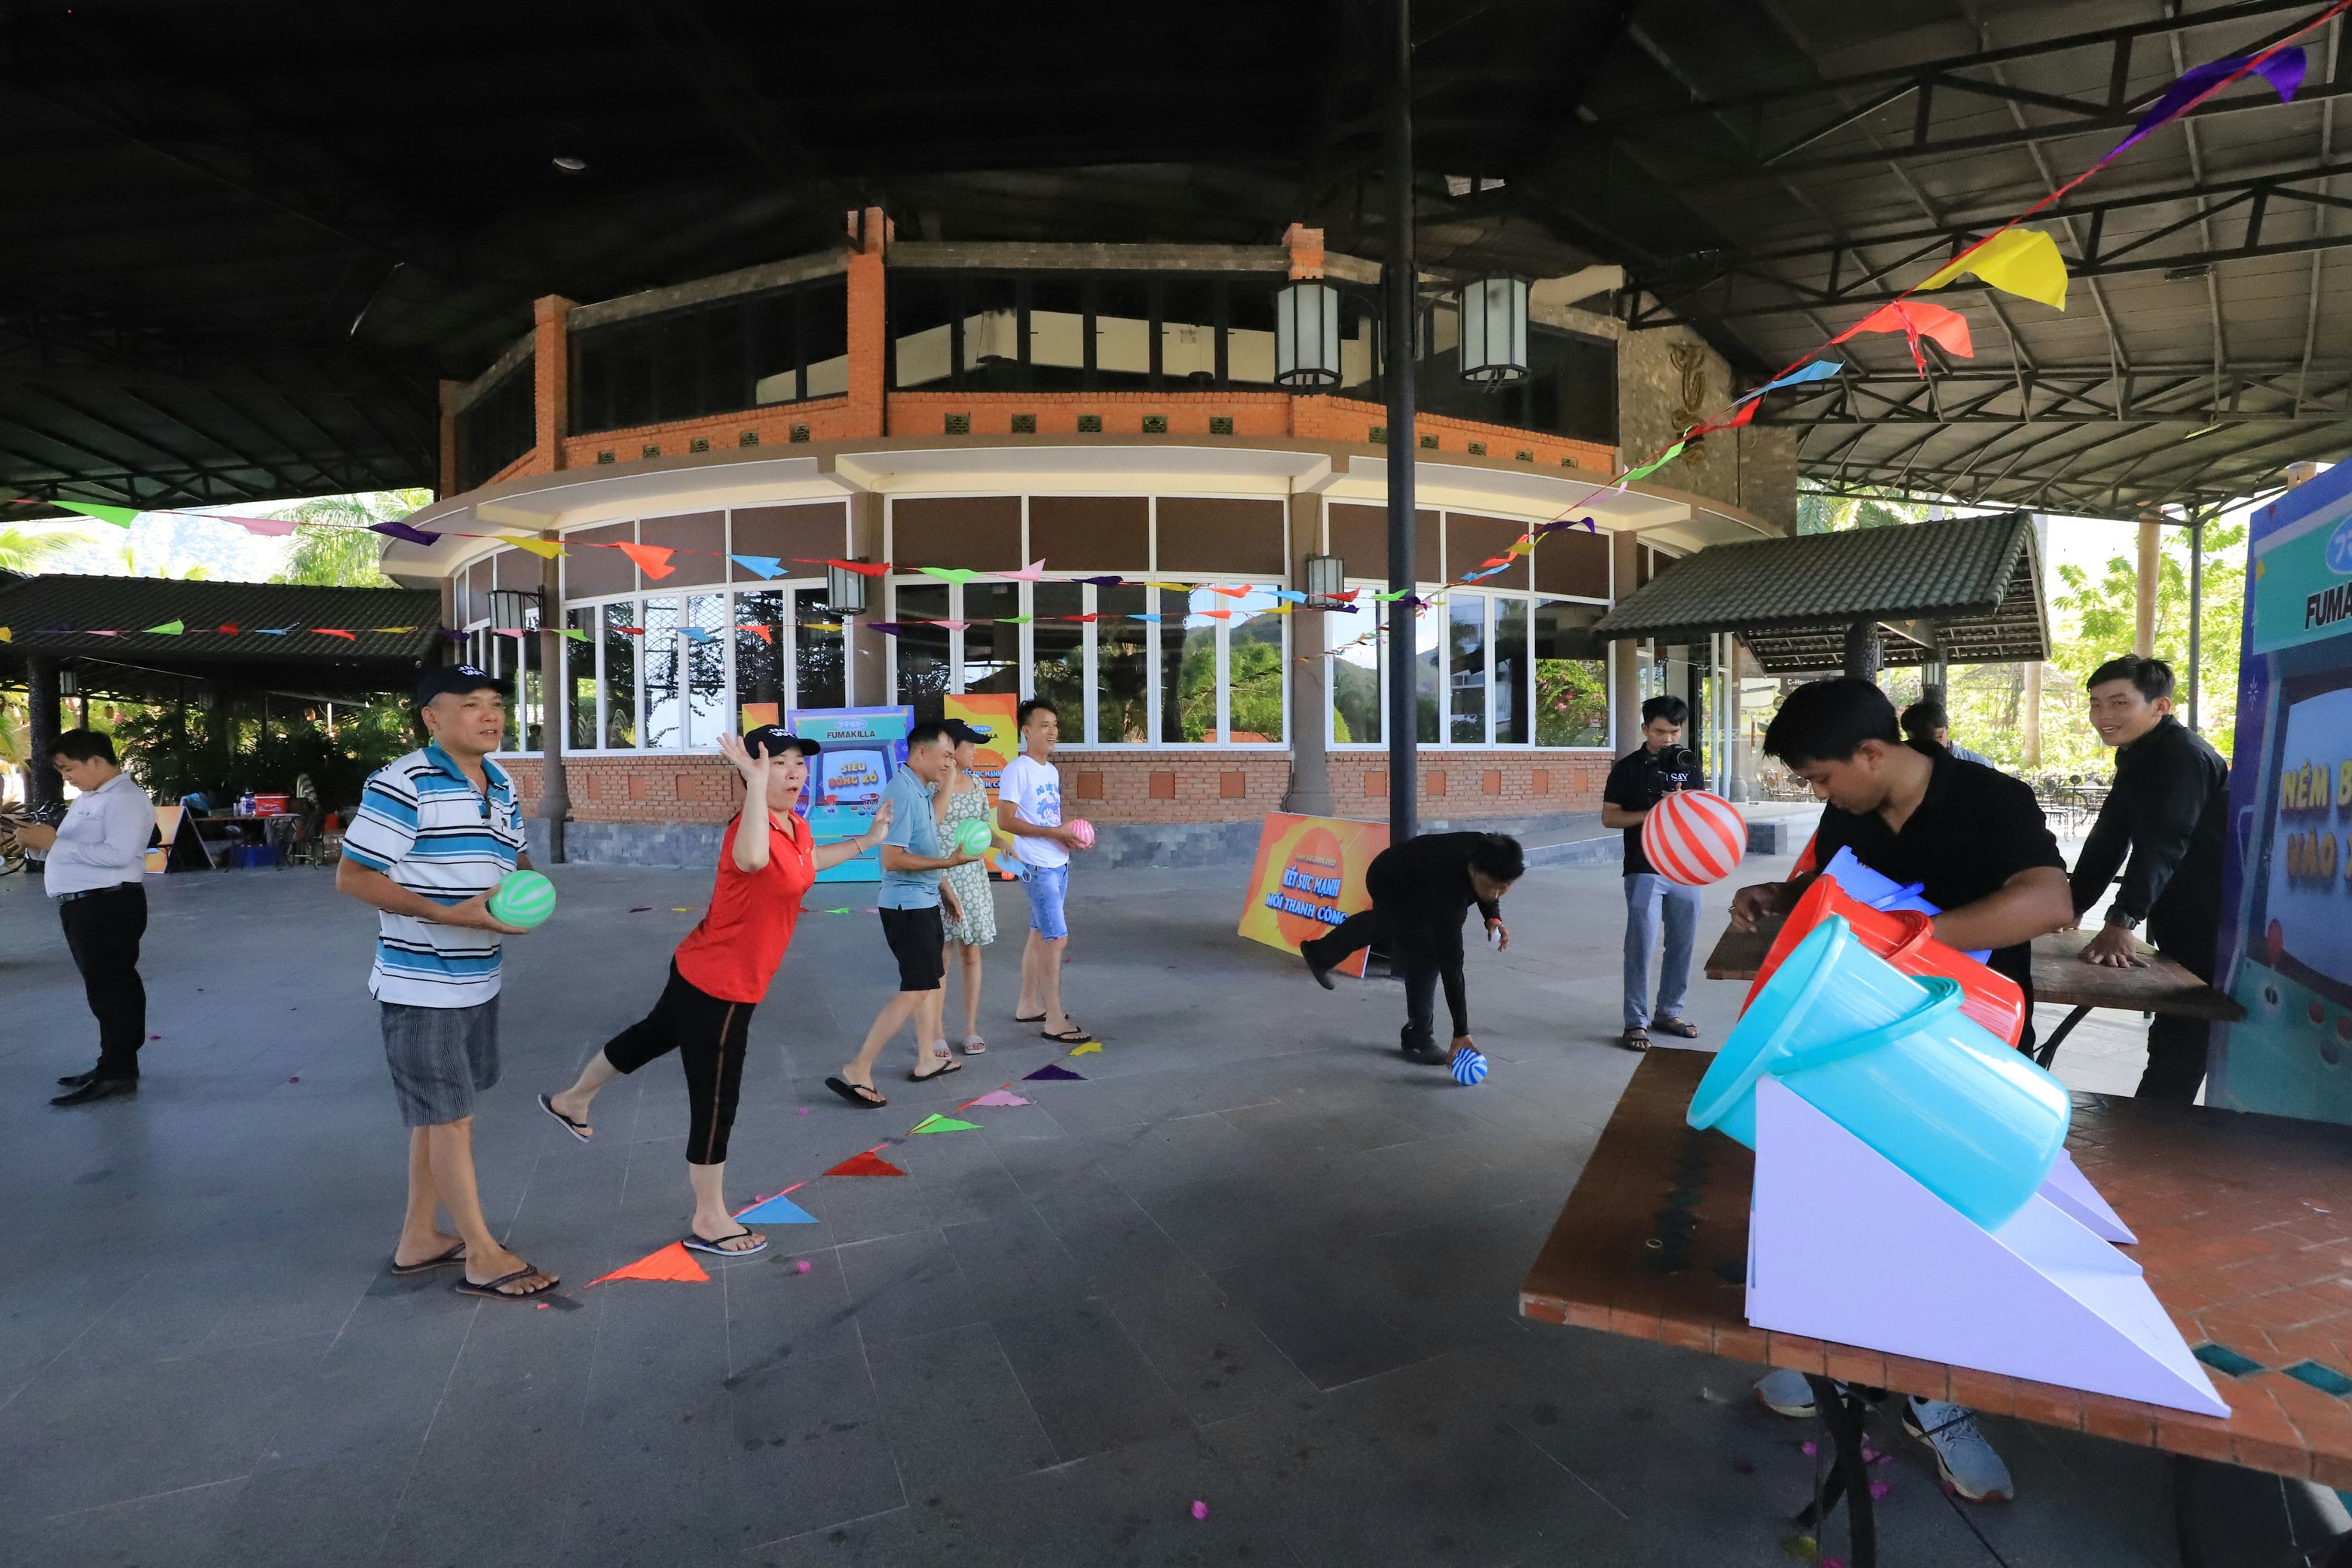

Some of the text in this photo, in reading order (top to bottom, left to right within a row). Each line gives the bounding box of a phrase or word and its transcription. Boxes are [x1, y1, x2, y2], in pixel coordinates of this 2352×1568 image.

[826, 730, 875, 739] FUMAKILLA
[2281, 759, 2329, 811] NÉM
[1282, 865, 1342, 899] KẾT SỨC MẠNH
[1265, 892, 1284, 910] NỐI
[1284, 898, 1316, 919] THÀNH
